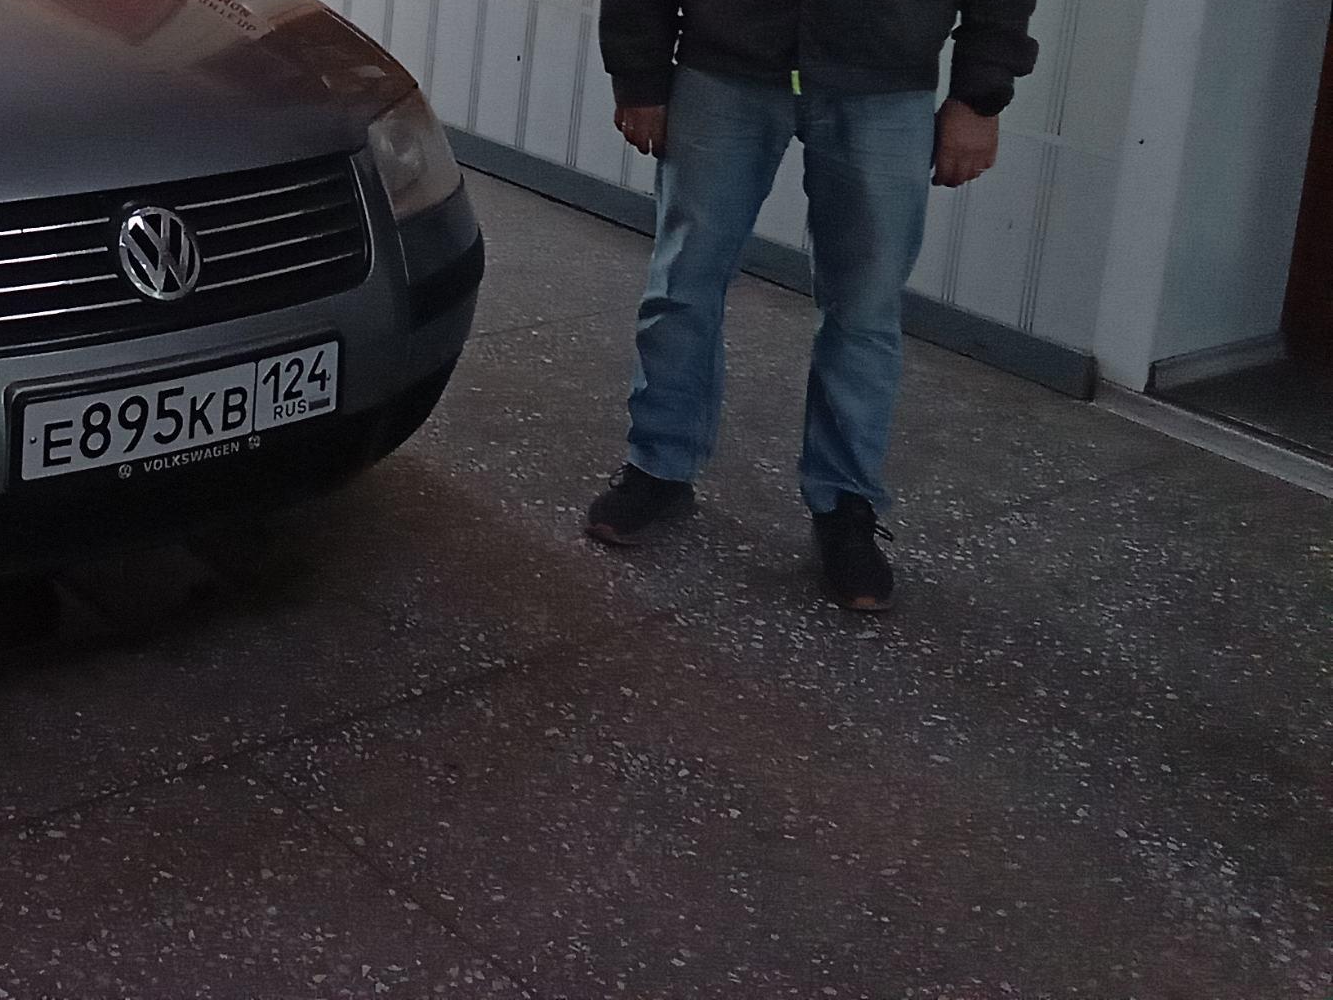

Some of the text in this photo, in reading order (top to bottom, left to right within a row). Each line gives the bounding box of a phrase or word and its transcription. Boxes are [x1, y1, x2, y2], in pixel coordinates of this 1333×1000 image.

[42, 350, 328, 468] E895KB 124
[273, 399, 307, 420] RUS
[143, 441, 240, 473] VOLKSWAGEN
